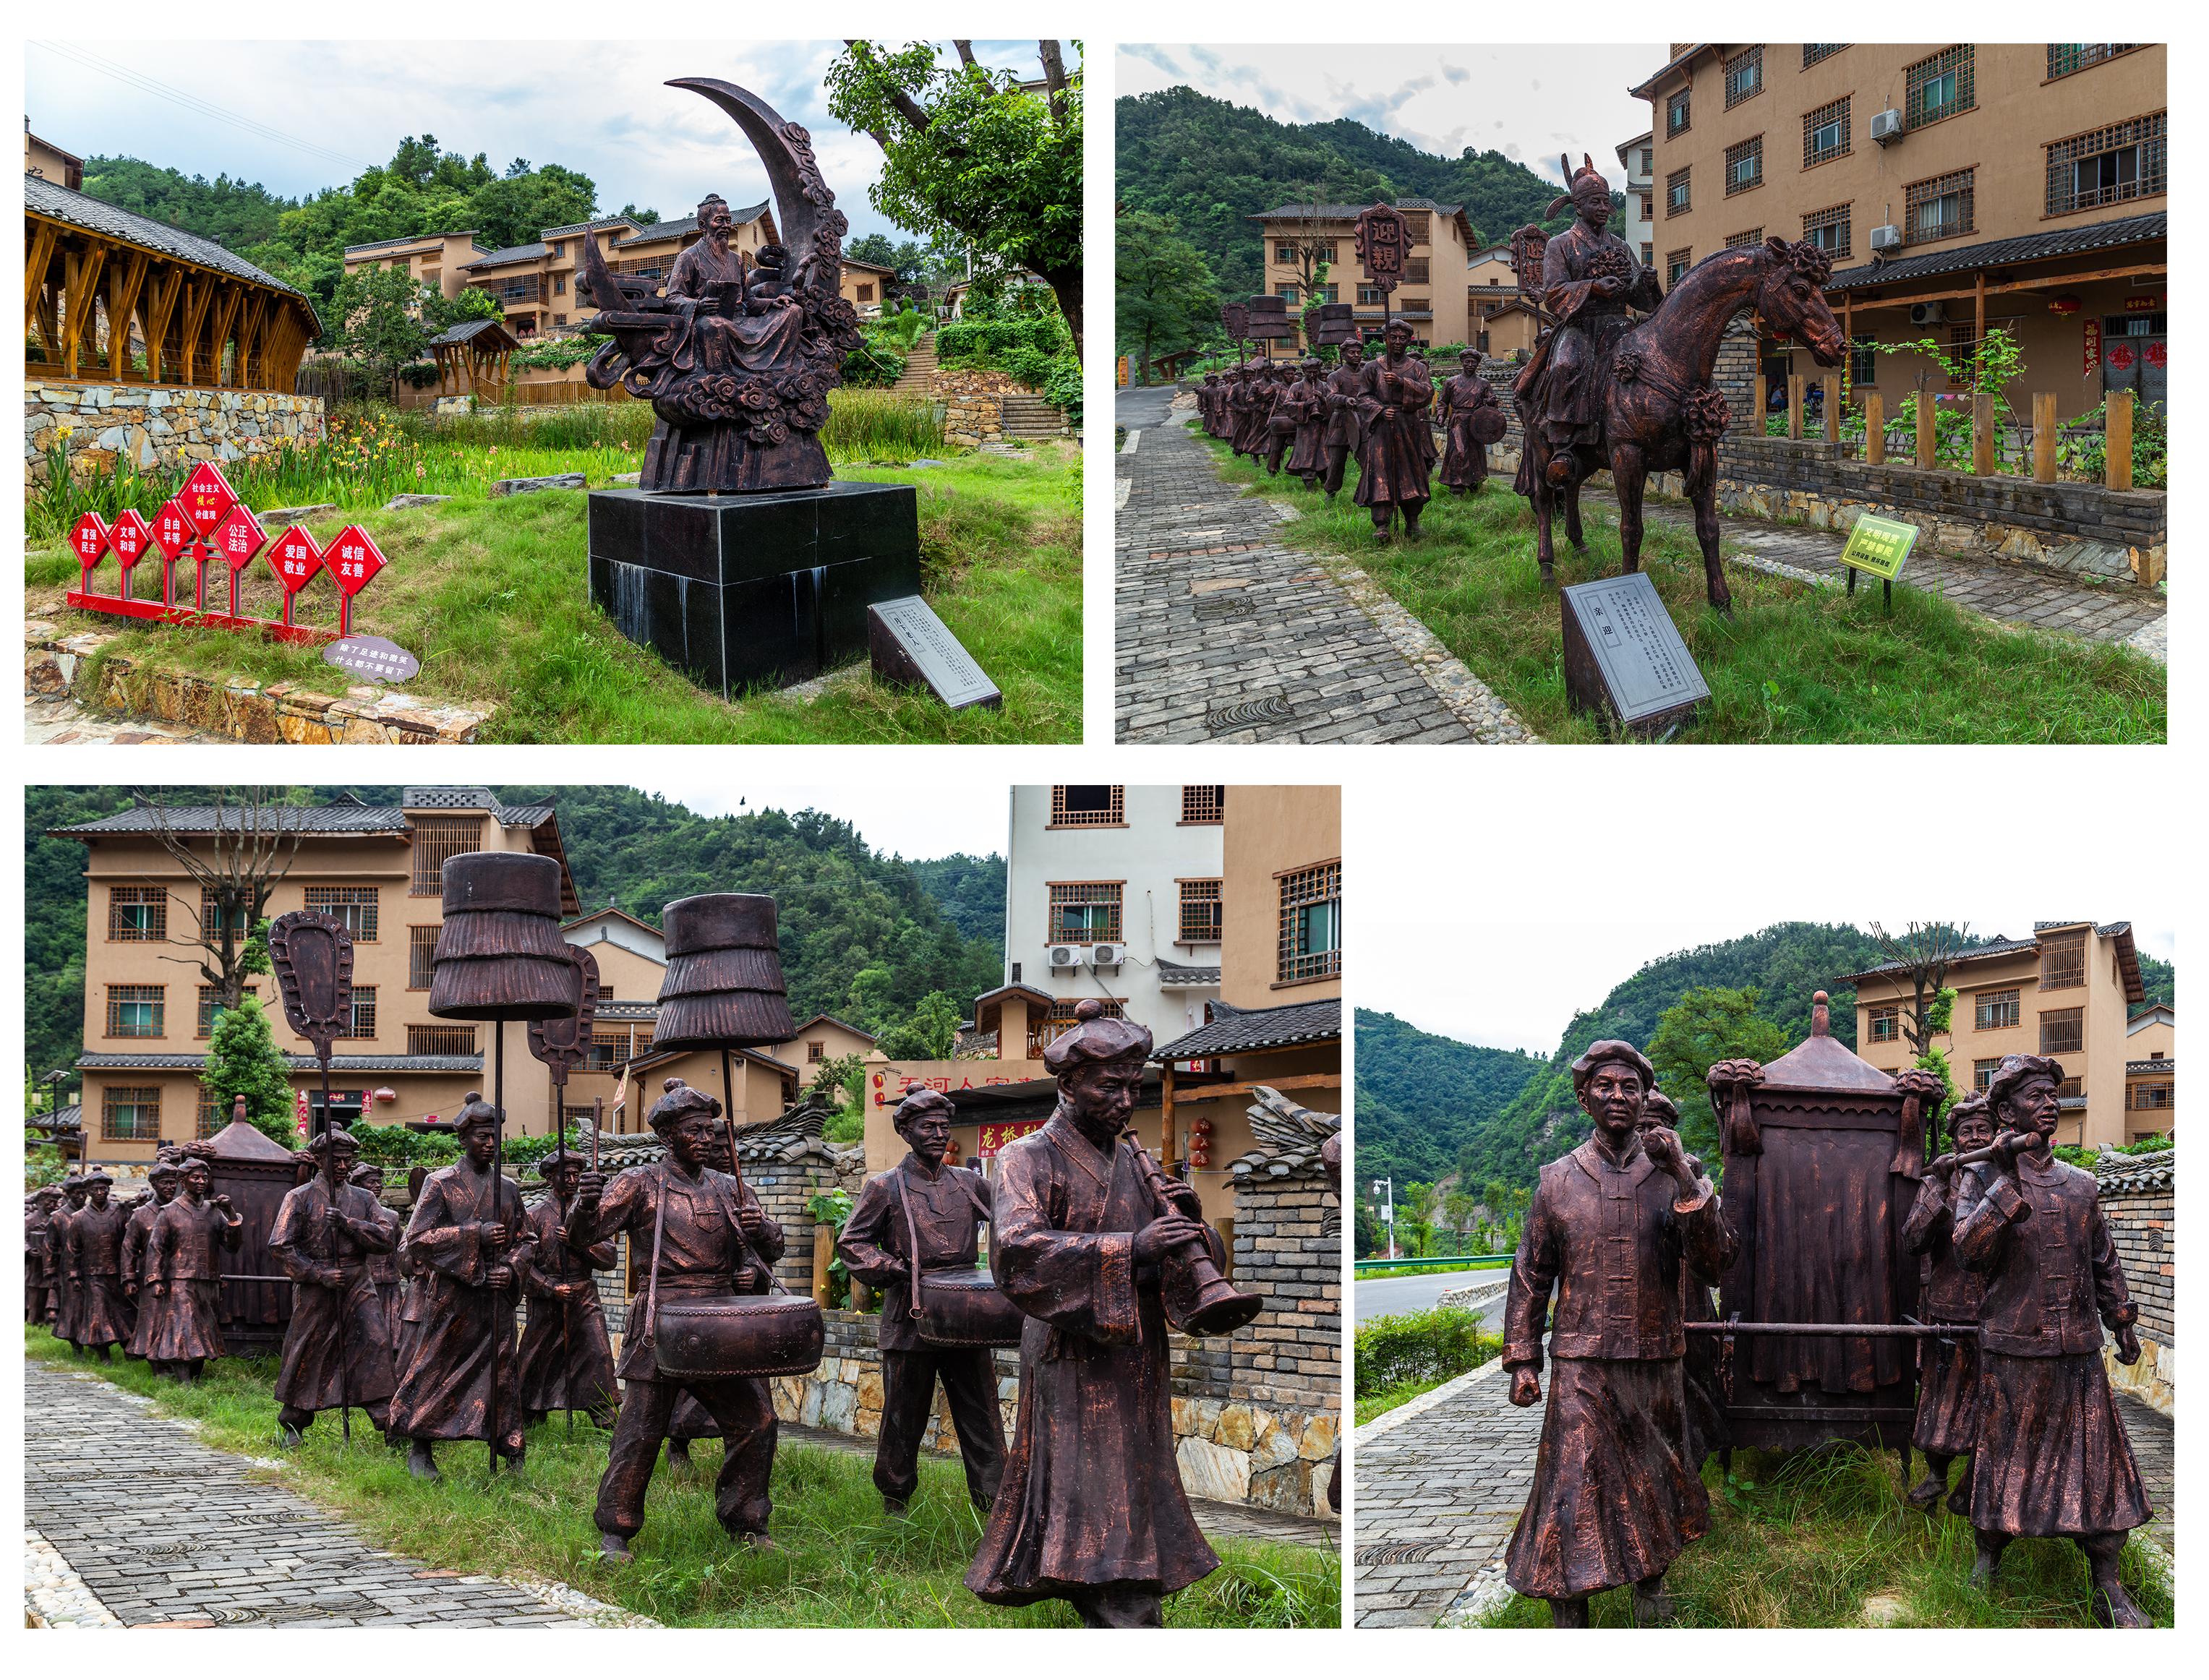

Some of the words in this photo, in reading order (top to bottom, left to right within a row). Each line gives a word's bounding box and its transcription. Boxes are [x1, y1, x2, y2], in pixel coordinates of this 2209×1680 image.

[192, 483, 220, 493] 社会主义
[197, 495, 215, 506] 核心
[195, 510, 216, 520] 价值观
[164, 518, 180, 530] 自由
[228, 524, 248, 539] 公正
[82, 528, 97, 541] 富强
[120, 526, 136, 539] 文明
[163, 532, 180, 545] 平等
[1863, 527, 1900, 544] 文明观赏
[81, 541, 96, 554] 民主
[119, 541, 136, 553] 和谐
[228, 538, 248, 553] 法治
[285, 544, 307, 560] 爱国
[341, 545, 365, 561] 诚信
[1858, 539, 1894, 557] 严禁攀爬
[284, 560, 306, 575] 敬业
[341, 562, 364, 578] 友善
[1594, 607, 1613, 635] 亲迎
[894, 617, 920, 646] 月下老人
[339, 643, 409, 664] 除了足迹和微笑
[335, 655, 404, 677] 什么都不要留下
